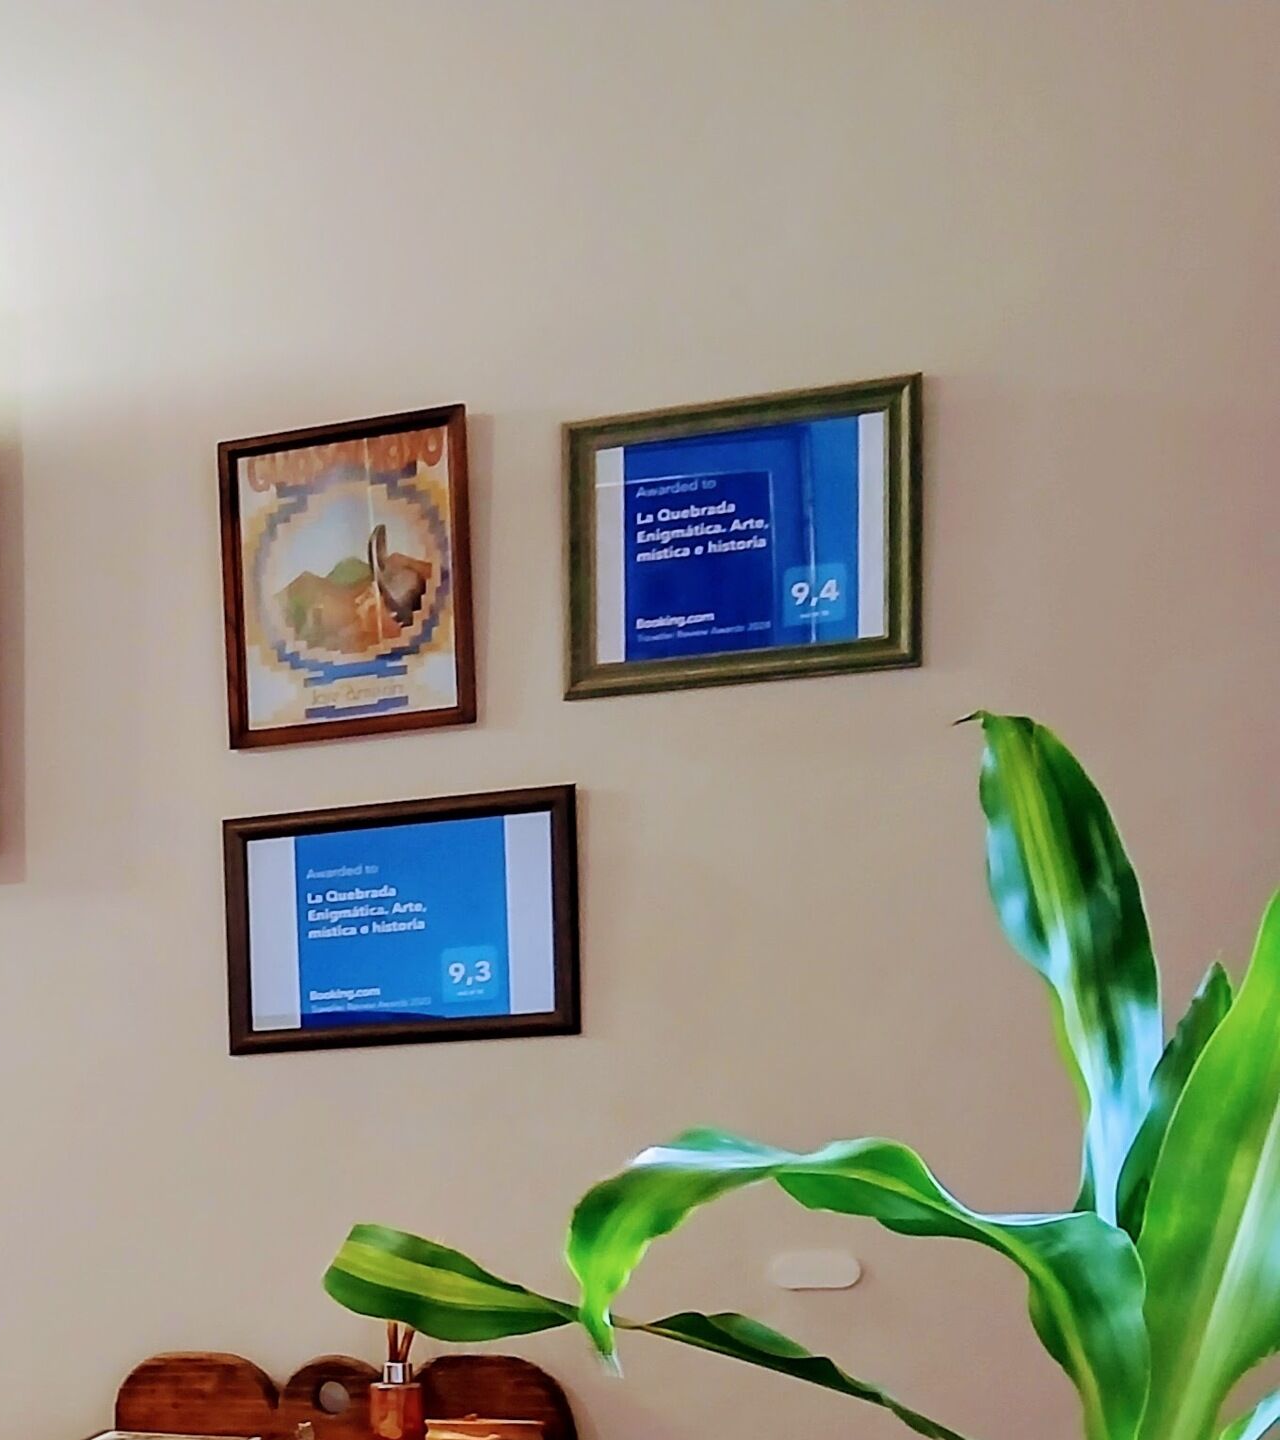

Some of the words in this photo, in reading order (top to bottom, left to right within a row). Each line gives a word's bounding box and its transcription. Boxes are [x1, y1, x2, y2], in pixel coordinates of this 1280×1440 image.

[636, 479, 698, 498] Awarded
[702, 479, 717, 490] to
[636, 512, 654, 525] La
[657, 500, 736, 522] Quebrada
[694, 545, 704, 555] e
[707, 535, 767, 553] historia
[791, 579, 839, 607] 9,4
[636, 613, 715, 629] Booking.com
[307, 892, 323, 904] La
[326, 884, 397, 902] Quebrada
[360, 925, 369, 934] e
[372, 917, 426, 933] historia
[448, 960, 492, 986] 9,3
